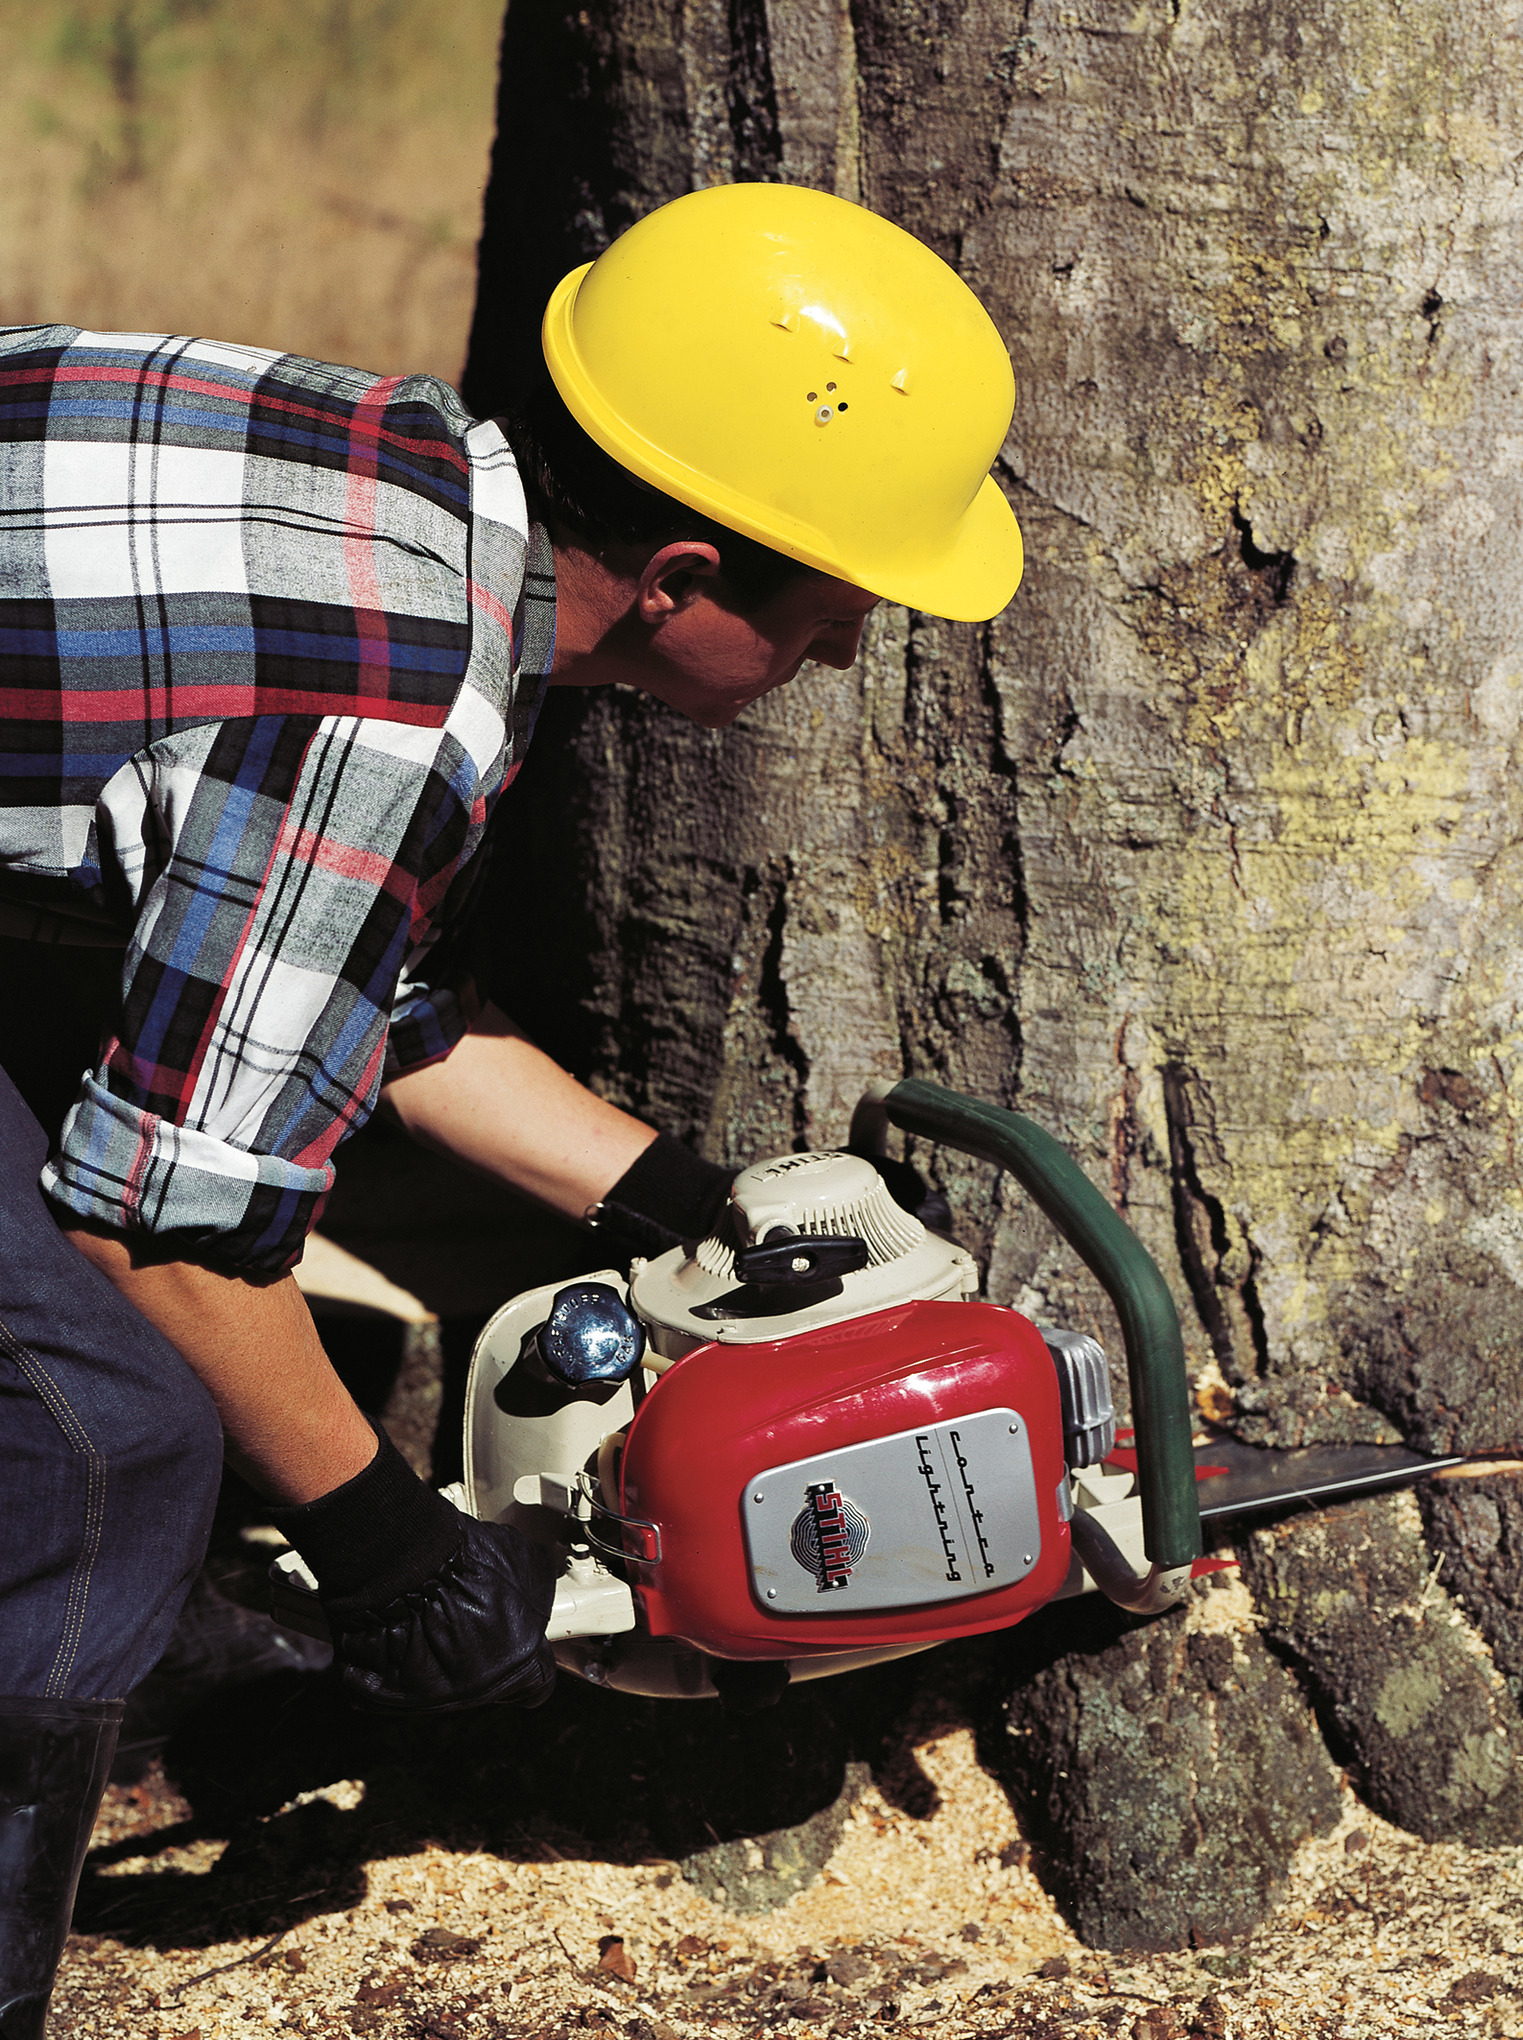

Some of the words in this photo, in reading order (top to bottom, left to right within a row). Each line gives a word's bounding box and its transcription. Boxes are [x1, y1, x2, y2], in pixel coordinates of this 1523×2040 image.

[765, 1152, 845, 1177] STIHL
[615, 1334, 635, 1363] GAS
[816, 1492, 852, 1580] STIHL
[915, 1435, 962, 1582] Lightning
